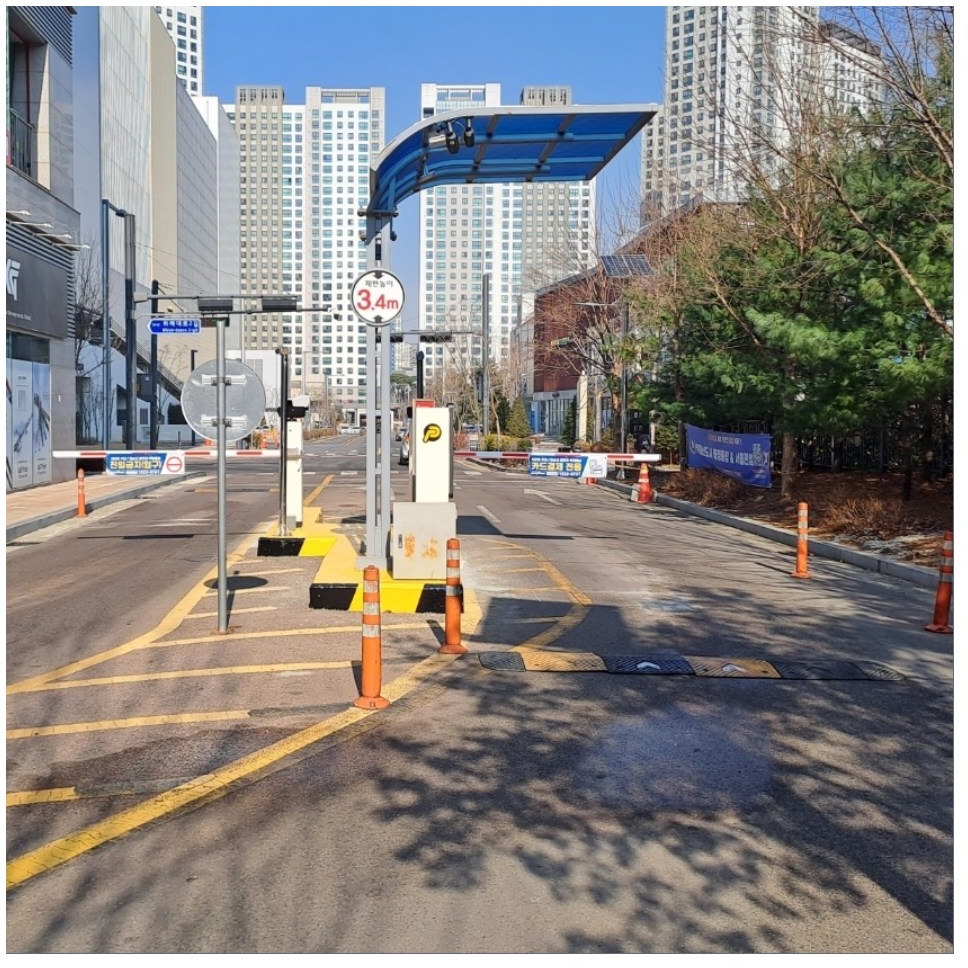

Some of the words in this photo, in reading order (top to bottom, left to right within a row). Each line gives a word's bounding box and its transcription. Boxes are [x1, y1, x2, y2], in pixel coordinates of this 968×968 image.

[365, 280, 393, 288] 제한높이
[356, 288, 400, 311] 3.4m
[110, 460, 162, 470] 진입금지(입구)
[531, 462, 564, 473] 카드결제
[565, 462, 582, 473] 전용
